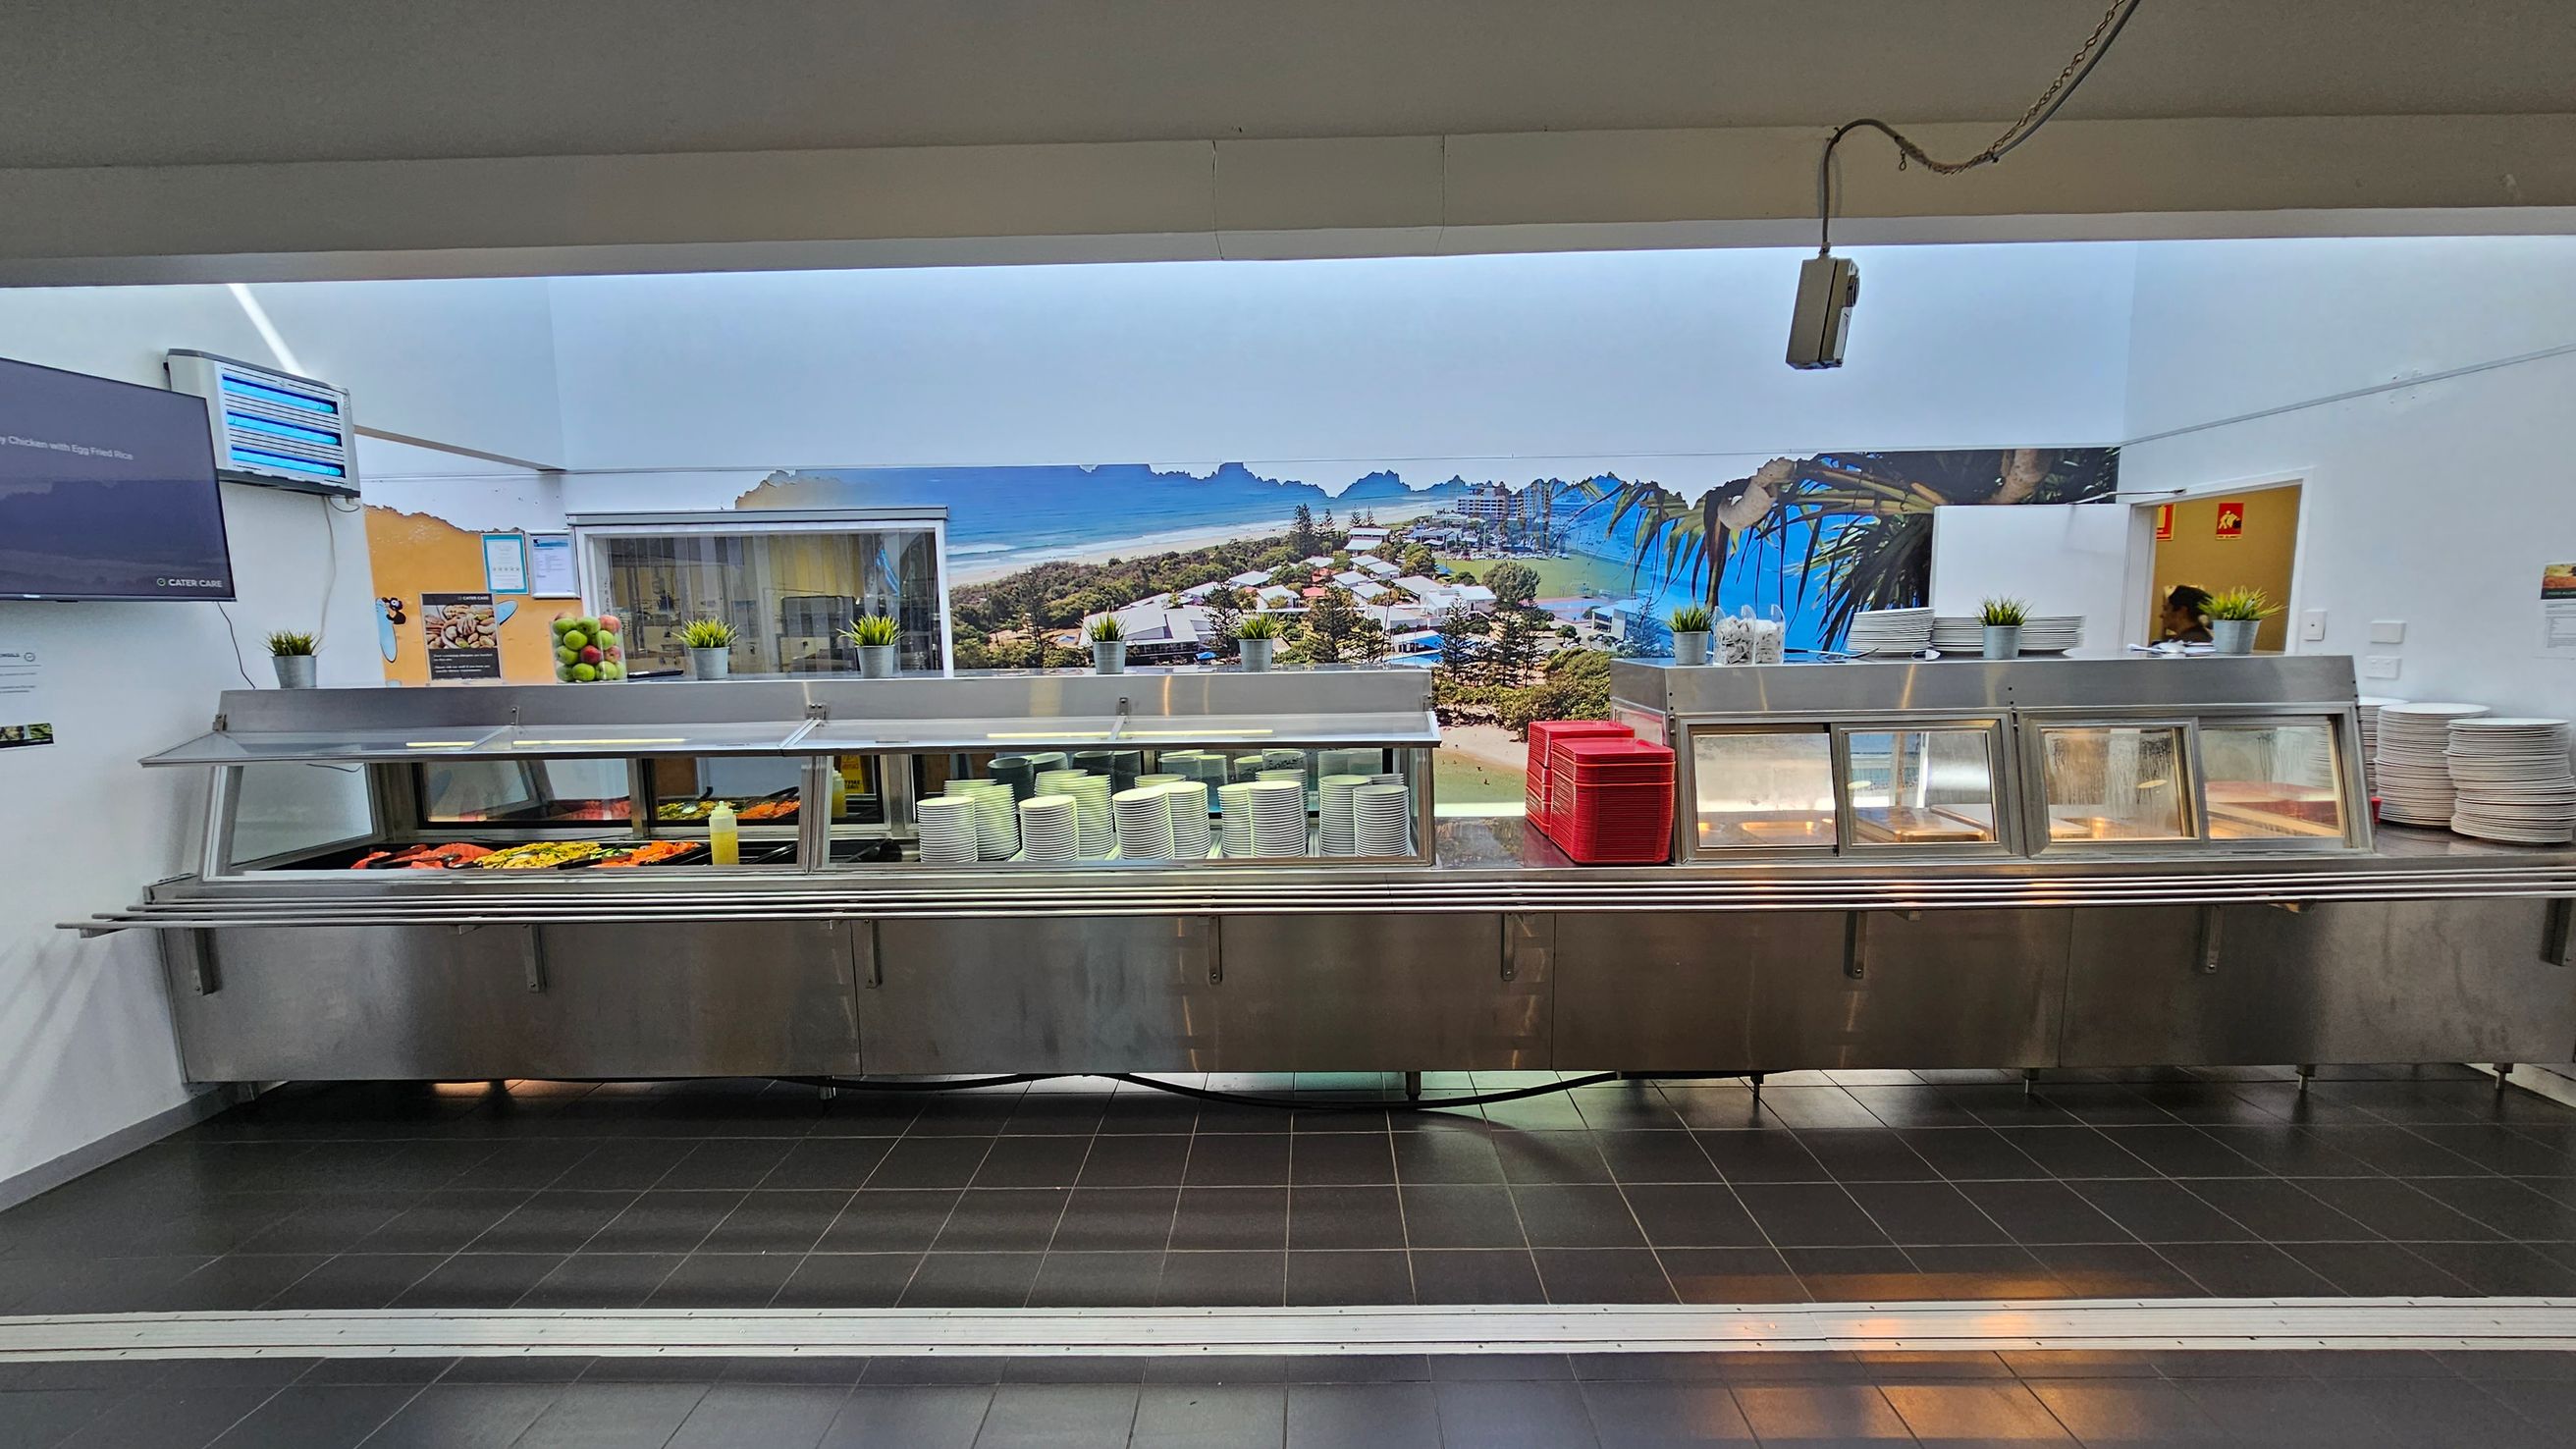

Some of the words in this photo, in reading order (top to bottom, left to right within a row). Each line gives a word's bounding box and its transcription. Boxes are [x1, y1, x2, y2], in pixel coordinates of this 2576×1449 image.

[8, 435, 48, 449] Chicken
[49, 443, 71, 452] with
[71, 444, 89, 456] Egg
[89, 447, 113, 457] Fried
[113, 450, 134, 460] Rice
[168, 578, 197, 587] CATER
[198, 579, 223, 588] CARE
